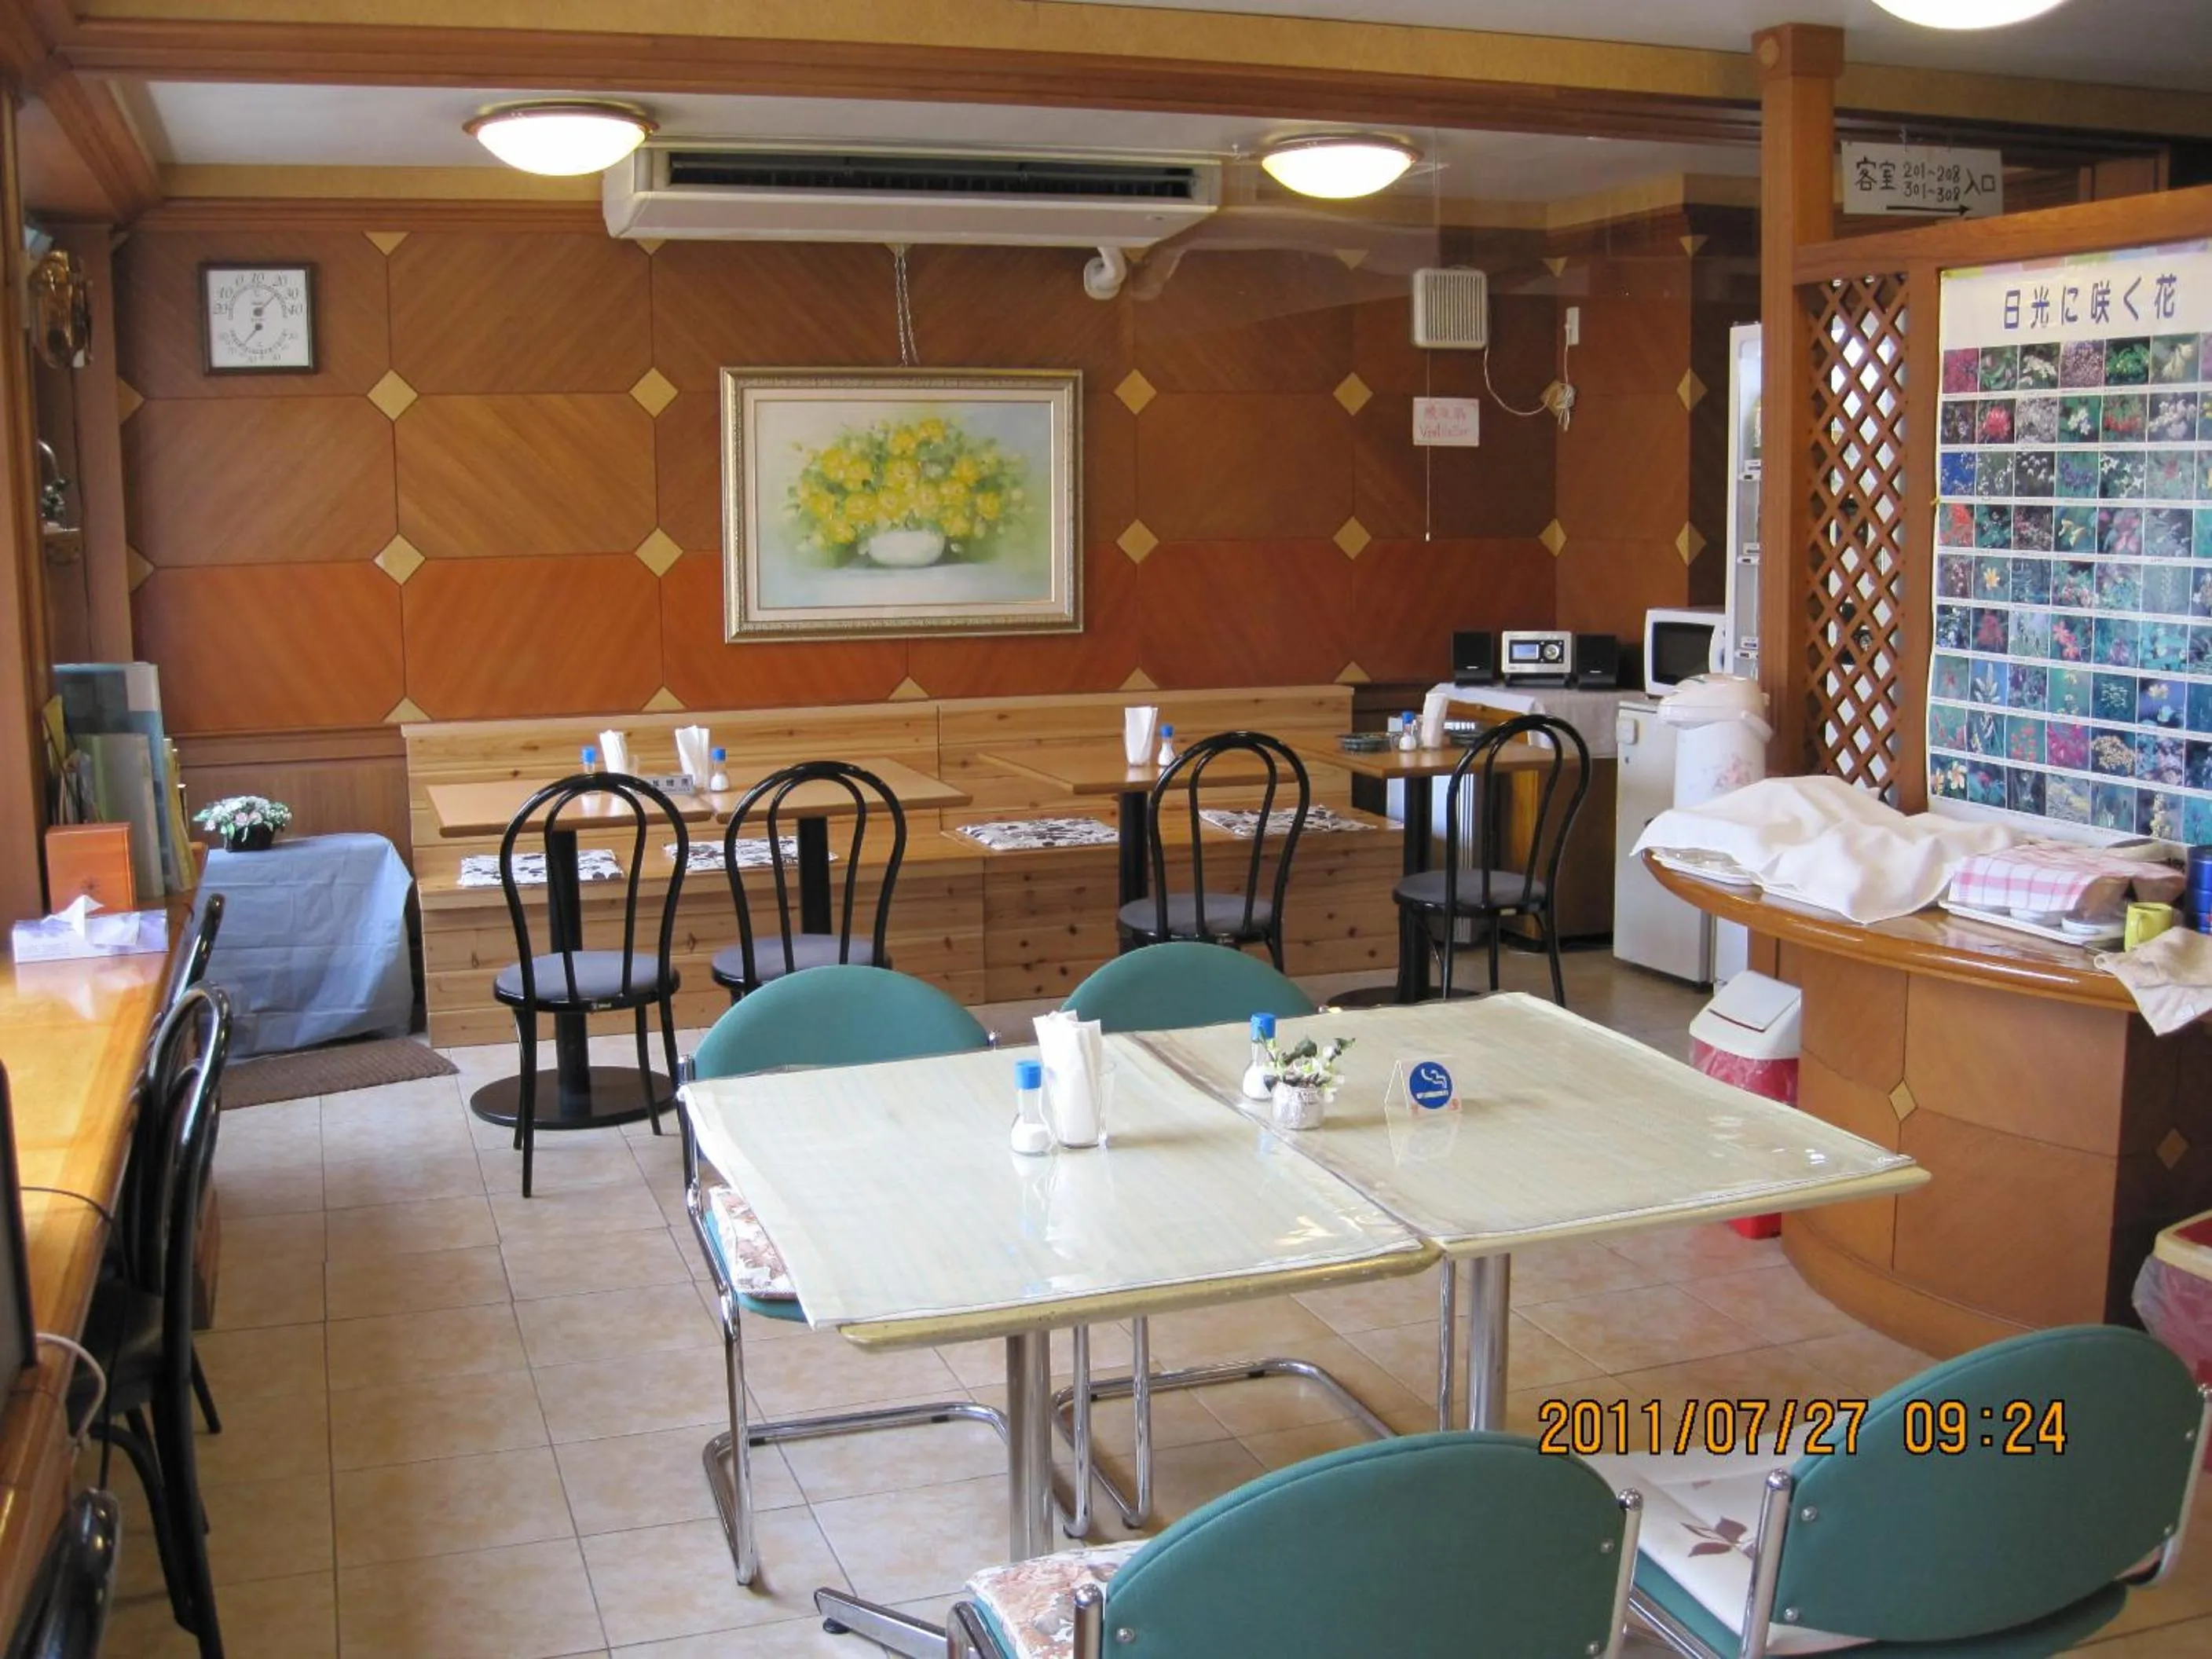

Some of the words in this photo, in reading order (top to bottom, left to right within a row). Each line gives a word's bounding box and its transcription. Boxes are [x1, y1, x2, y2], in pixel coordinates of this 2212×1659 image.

[1855, 155, 1896, 191] 客室
[1965, 168, 1996, 196] 入口
[2004, 273, 2177, 329] 日光に咲く花
